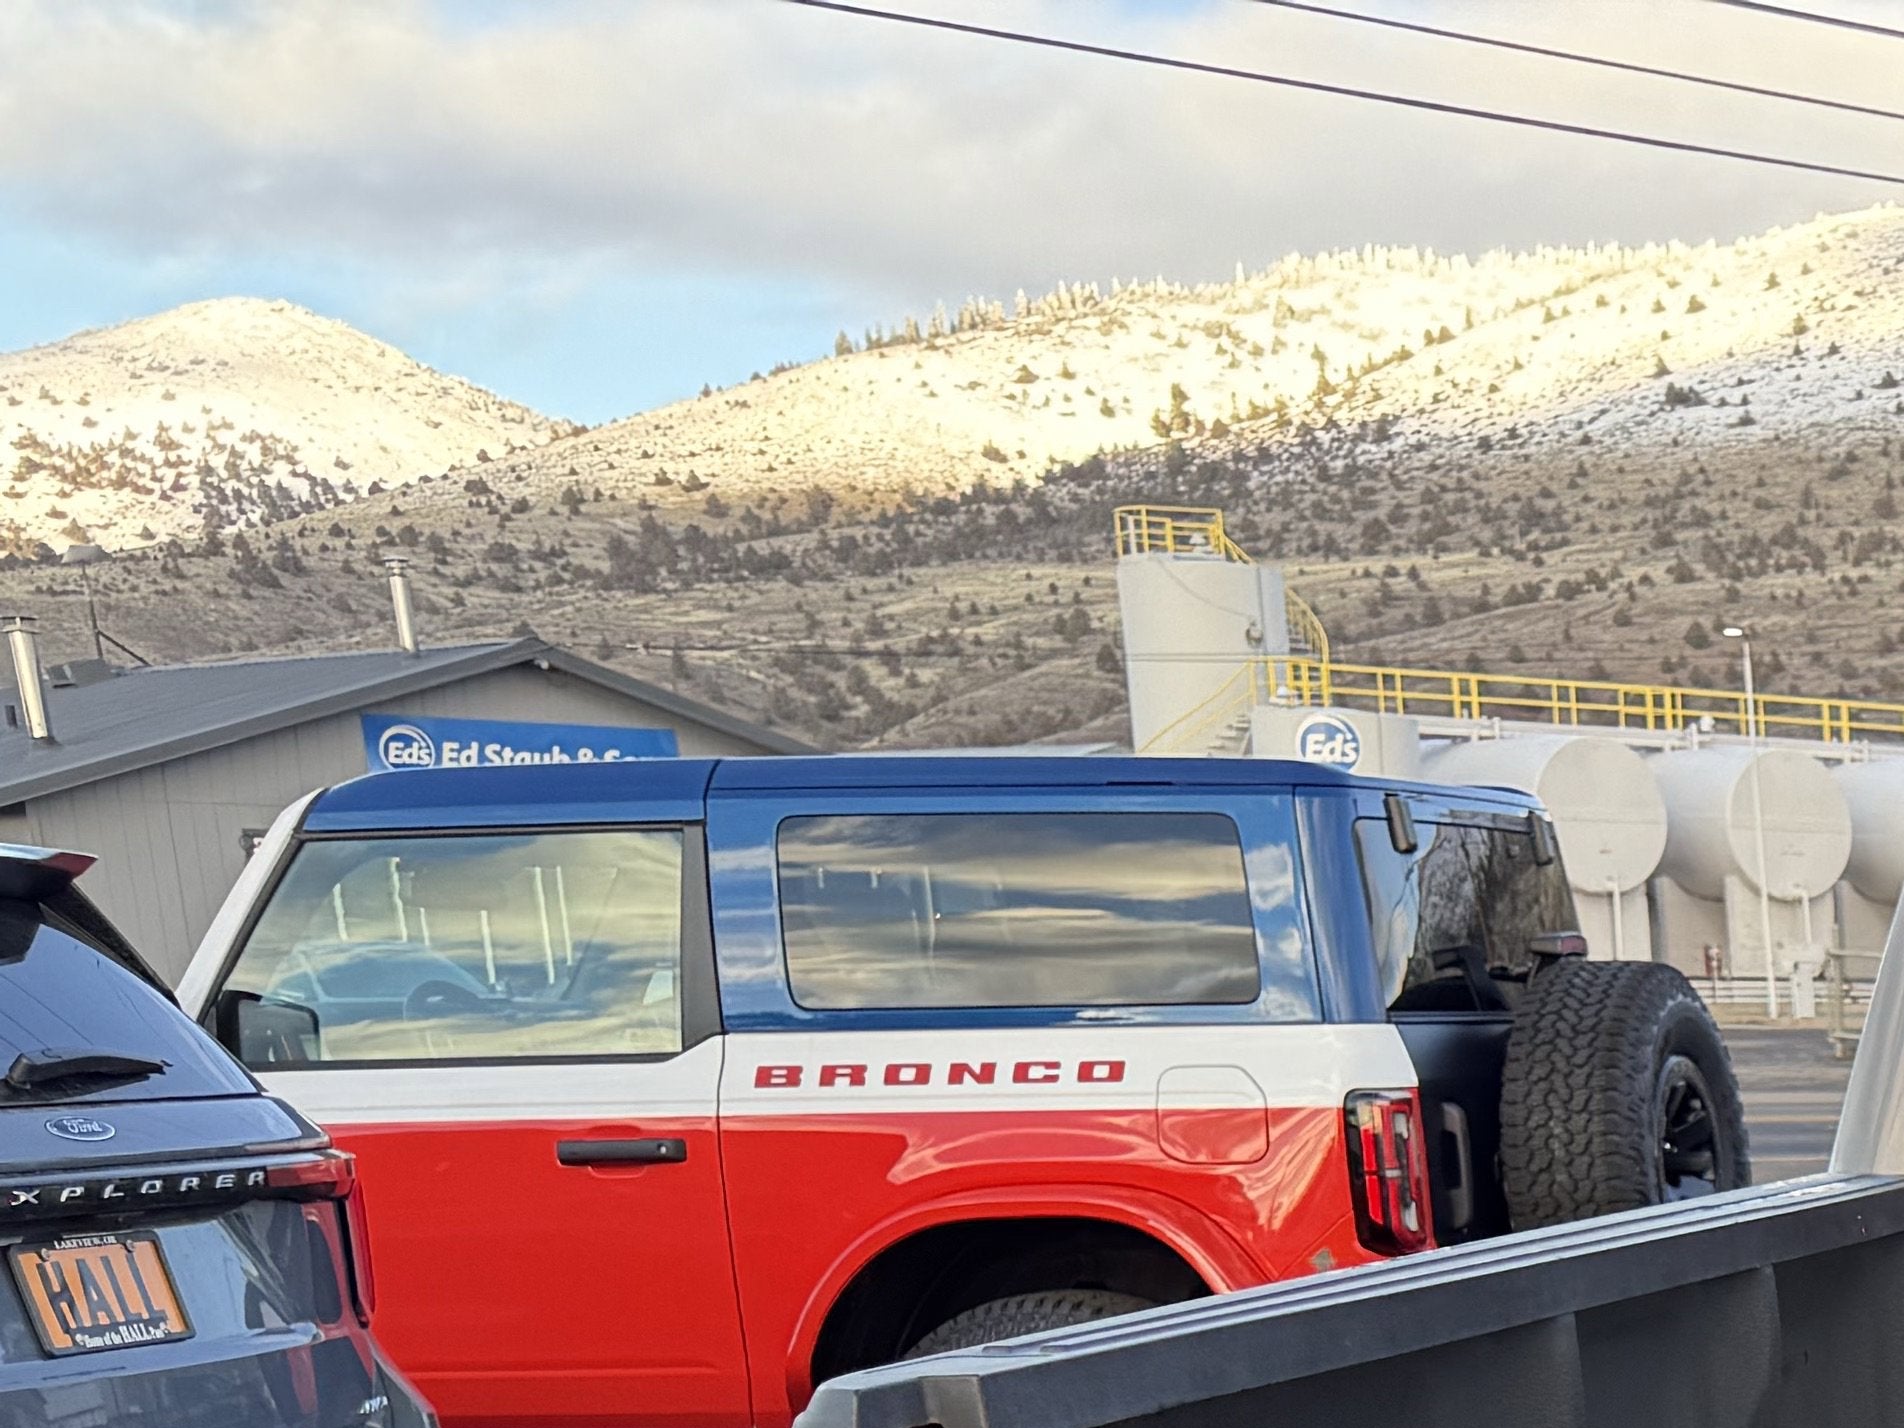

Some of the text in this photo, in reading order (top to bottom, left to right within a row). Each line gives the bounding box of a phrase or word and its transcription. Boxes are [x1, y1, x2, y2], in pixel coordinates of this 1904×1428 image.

[441, 741, 479, 766] Ed
[484, 743, 572, 766] Staub
[754, 1060, 1126, 1089] BRONCO
[10, 1171, 267, 1205] XPLORER
[36, 1254, 168, 1333] HALL
[119, 1323, 151, 1343] HALL
